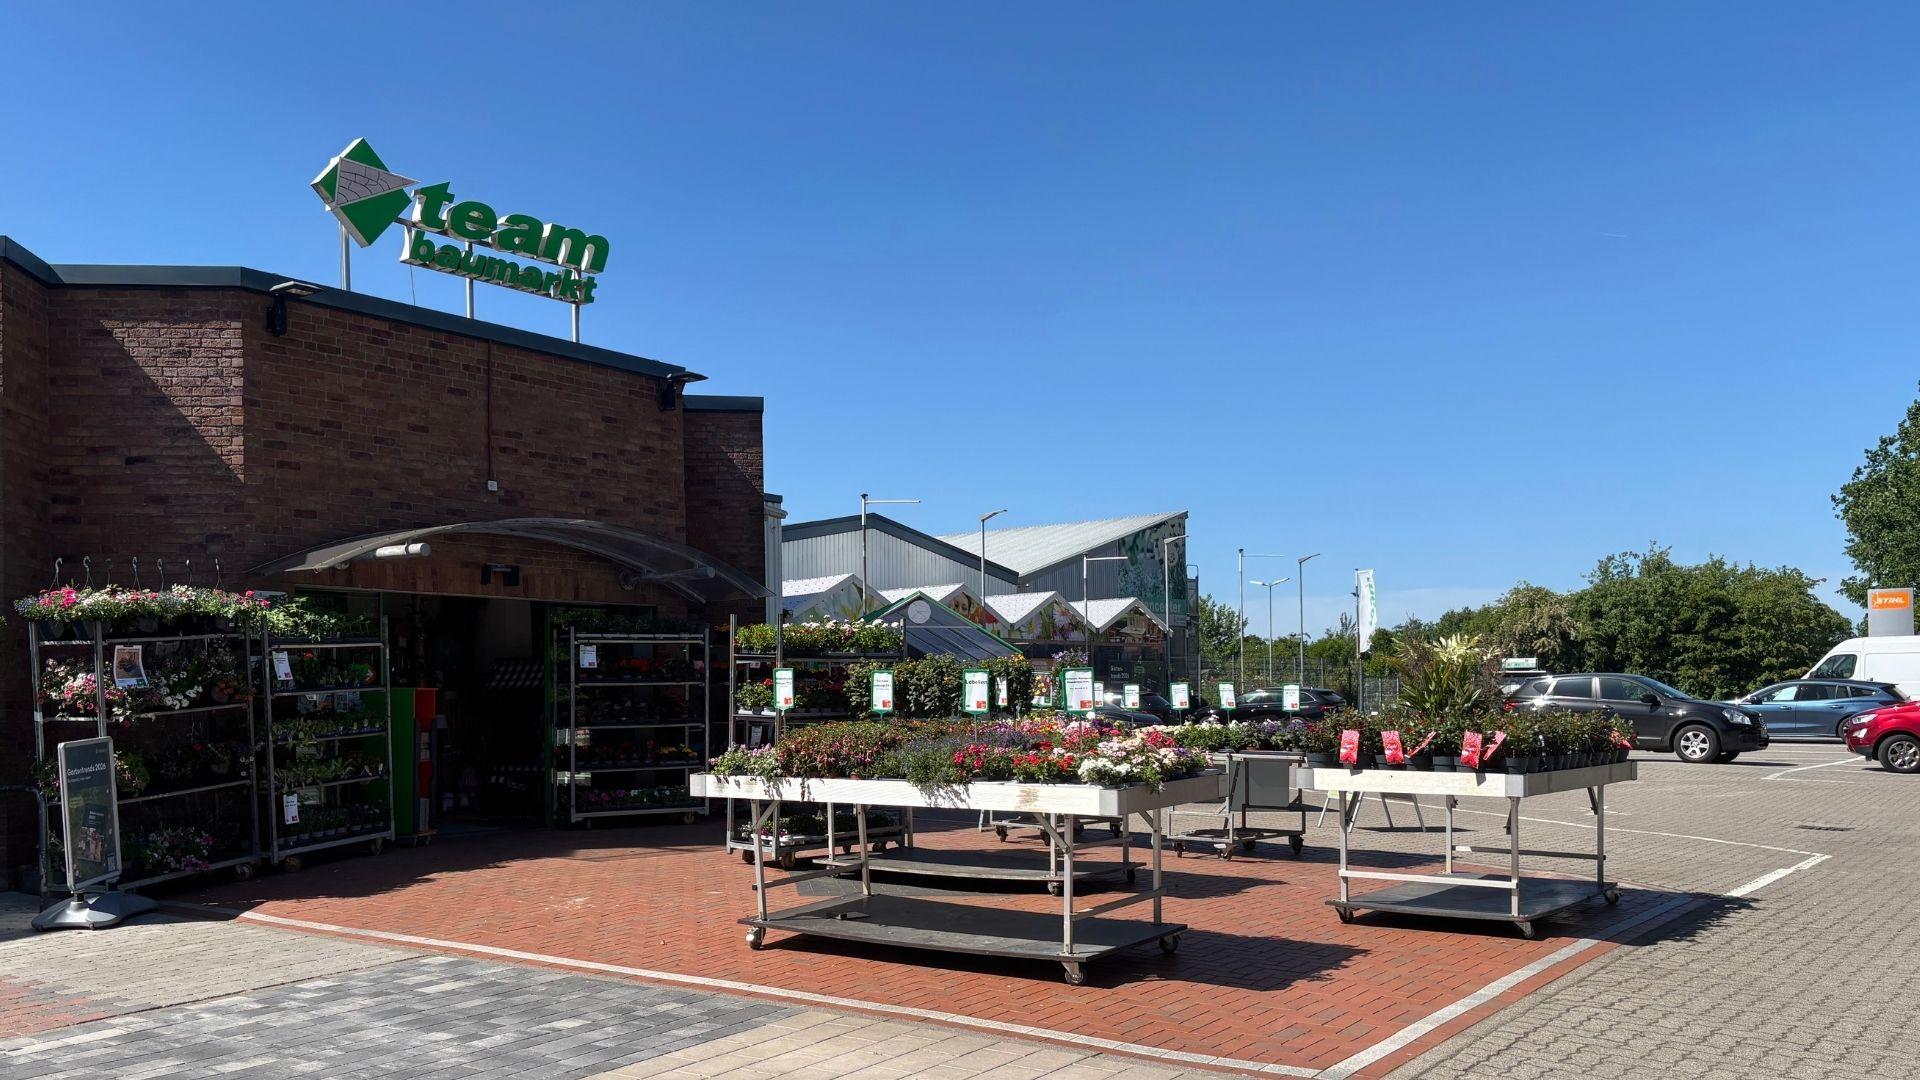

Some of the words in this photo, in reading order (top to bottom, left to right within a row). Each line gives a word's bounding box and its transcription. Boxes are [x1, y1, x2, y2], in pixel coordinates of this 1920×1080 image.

[410, 181, 610, 275] team
[400, 229, 598, 304] baumarkt
[1877, 596, 1905, 604] STIHL
